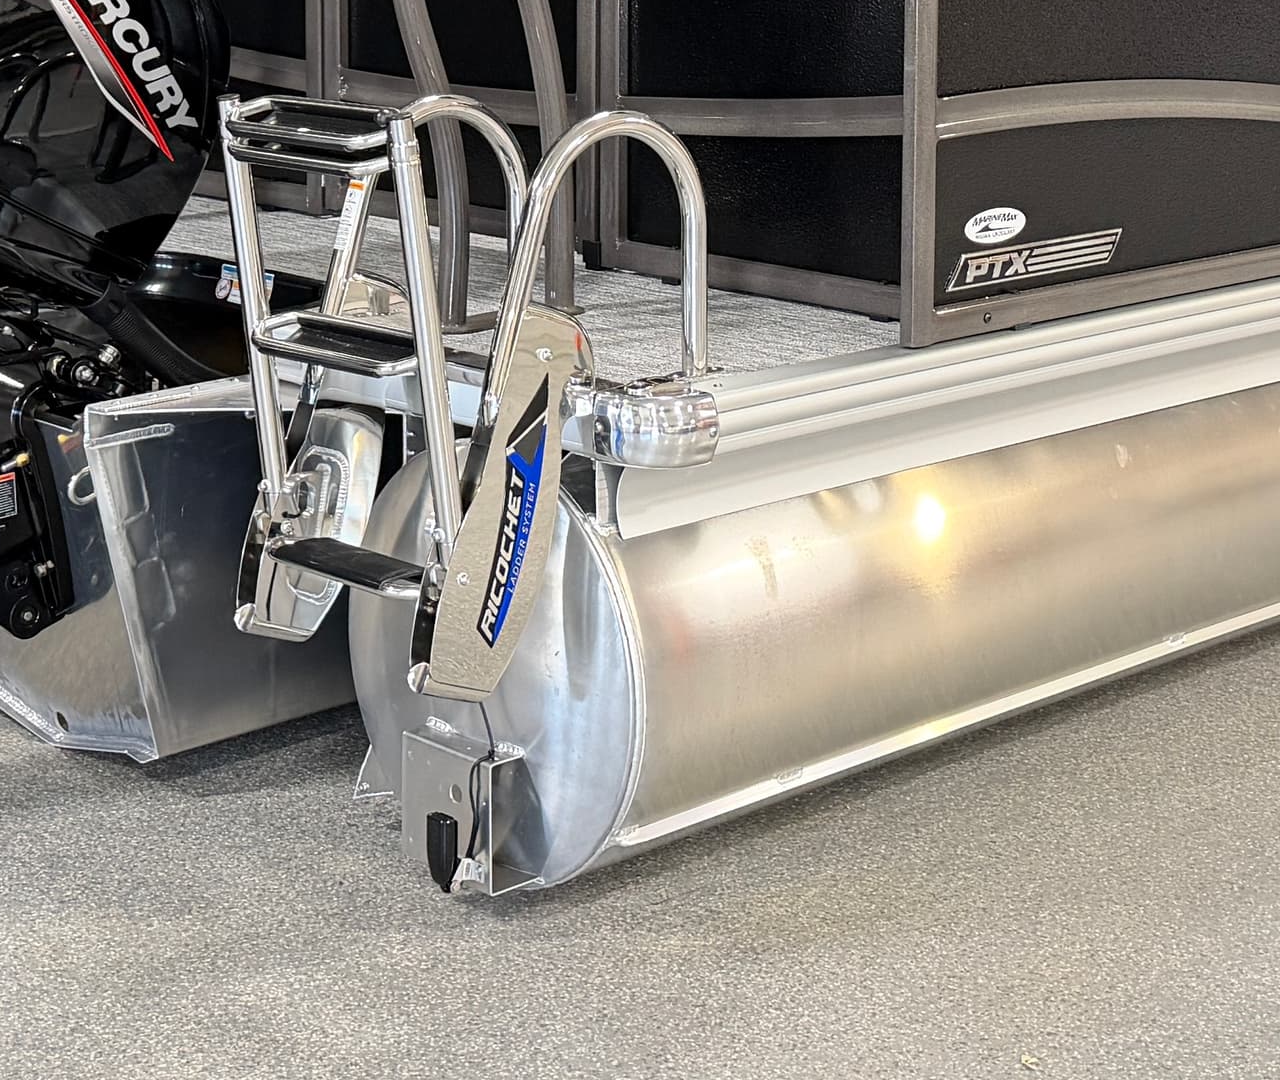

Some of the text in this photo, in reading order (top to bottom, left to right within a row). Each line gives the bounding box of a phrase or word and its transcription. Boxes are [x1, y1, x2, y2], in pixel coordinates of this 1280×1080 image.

[965, 250, 1031, 283] PTX
[481, 468, 525, 642] RICOCHET
[508, 482, 536, 594] LADDER SYSTEM
